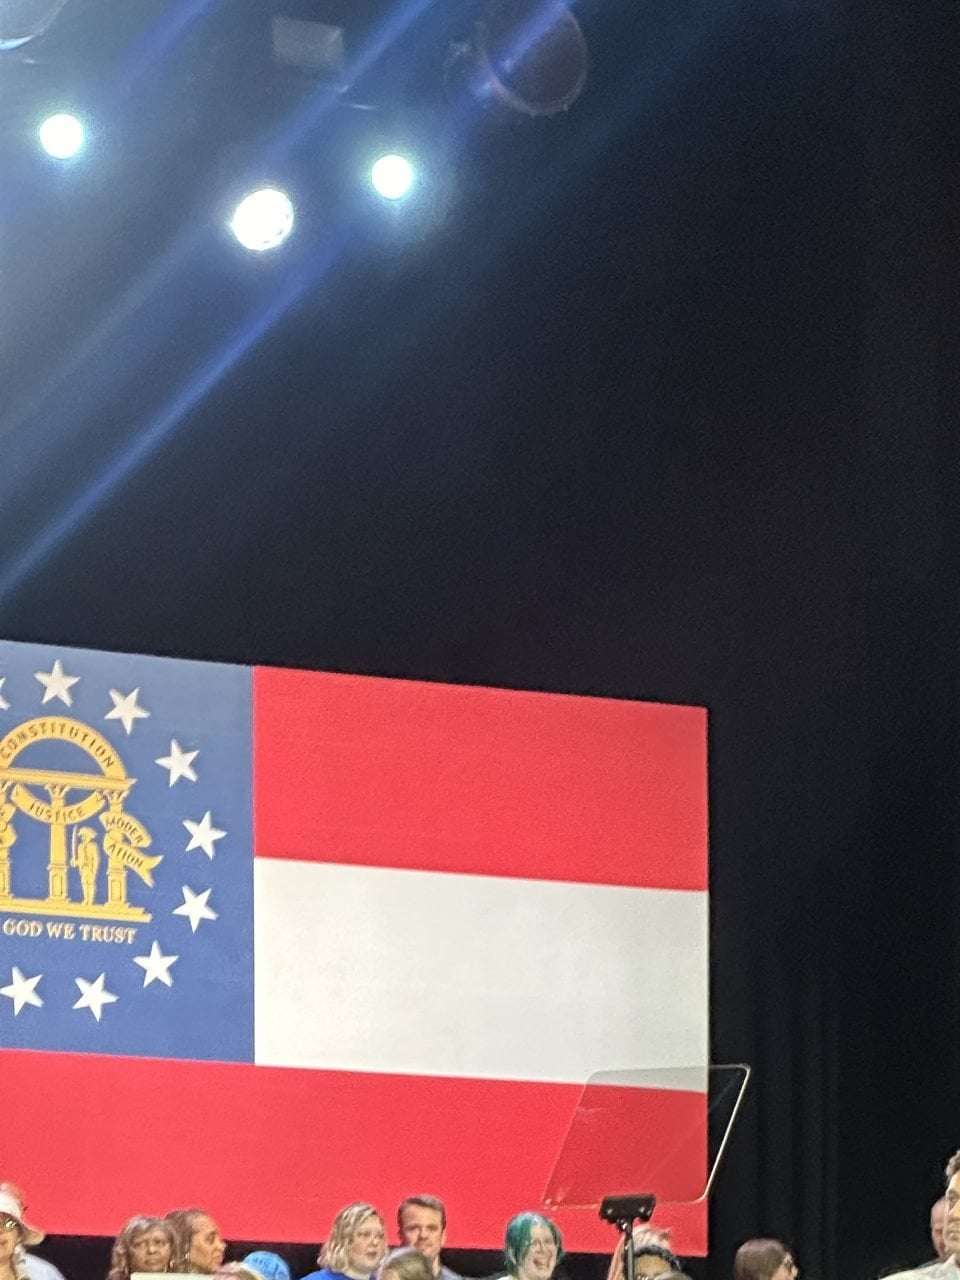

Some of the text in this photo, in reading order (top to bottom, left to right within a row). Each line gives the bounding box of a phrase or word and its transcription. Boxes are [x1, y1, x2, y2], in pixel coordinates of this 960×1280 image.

[0, 722, 114, 769] CONSTITUTION
[29, 802, 84, 822] JUSTICE
[3, 918, 138, 945] GOD WE TRUST
